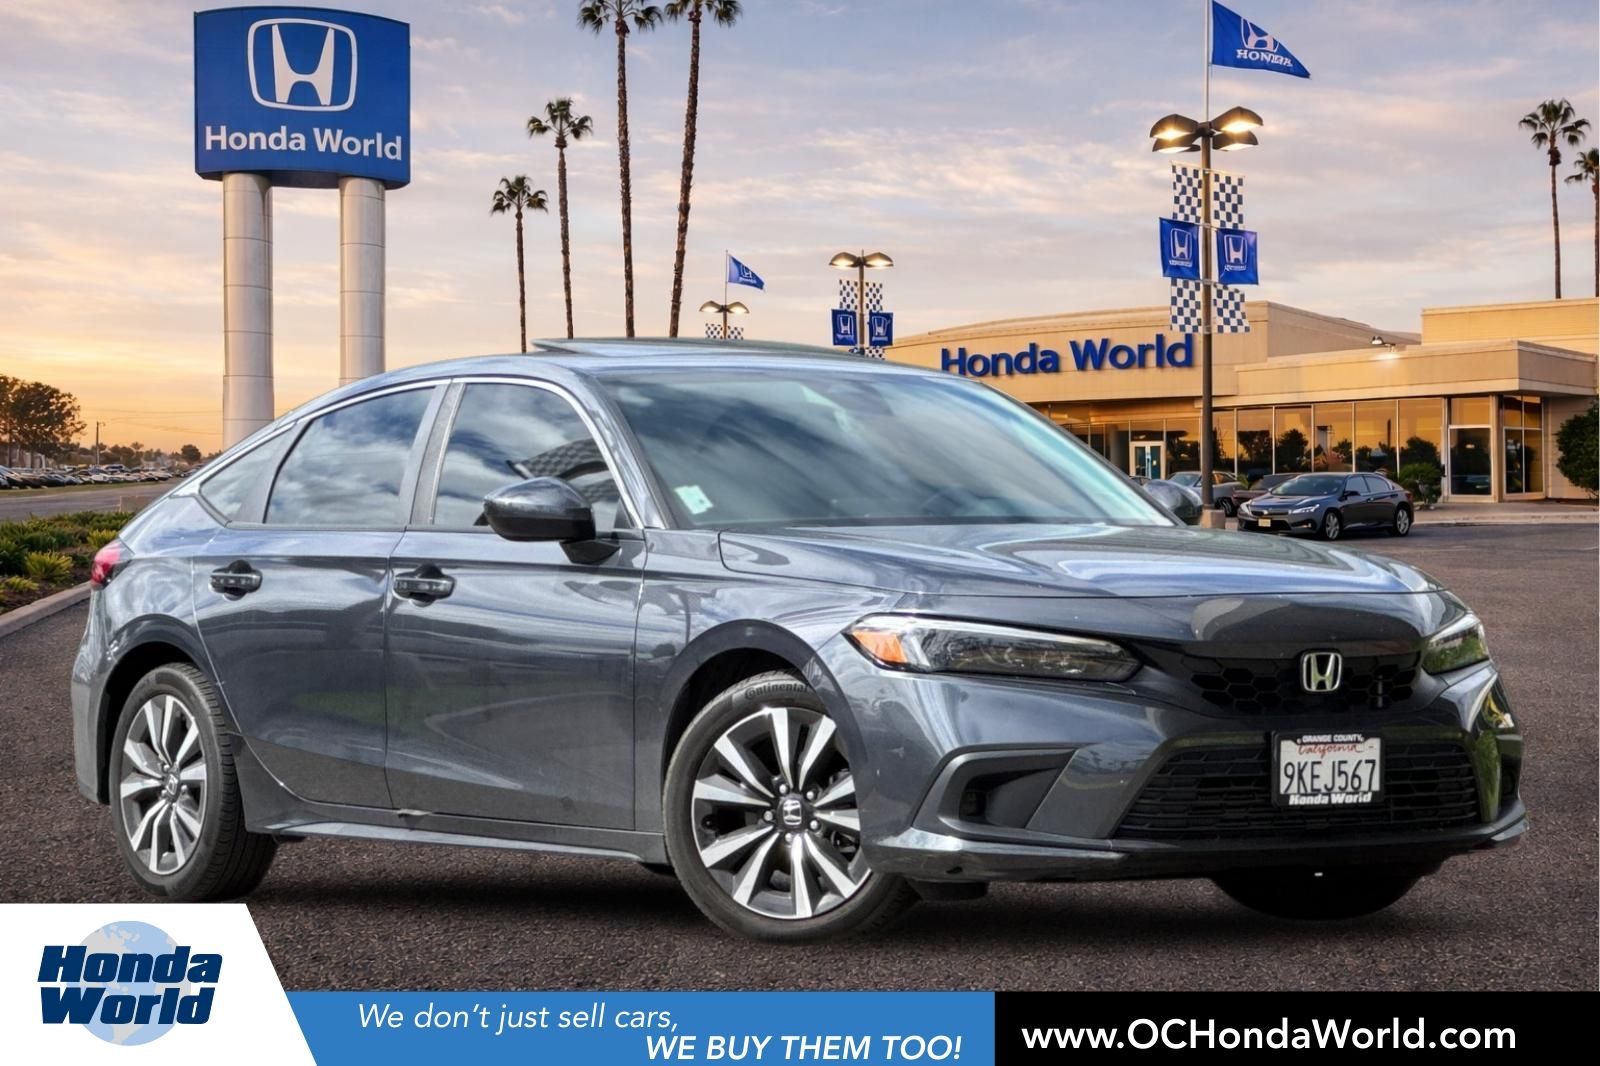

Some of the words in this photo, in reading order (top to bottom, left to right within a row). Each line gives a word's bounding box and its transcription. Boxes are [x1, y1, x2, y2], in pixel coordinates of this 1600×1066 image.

[205, 125, 306, 151] Honda
[313, 127, 402, 160] World
[941, 342, 1061, 377] Honda
[1070, 333, 1195, 371] World
[745, 682, 808, 700] Continental
[1302, 734, 1332, 743] ORANGE
[1333, 734, 1362, 743] COUNTY
[1283, 759, 1377, 794] 9KEJ567
[1288, 793, 1329, 806] Honda
[1331, 791, 1373, 804] World
